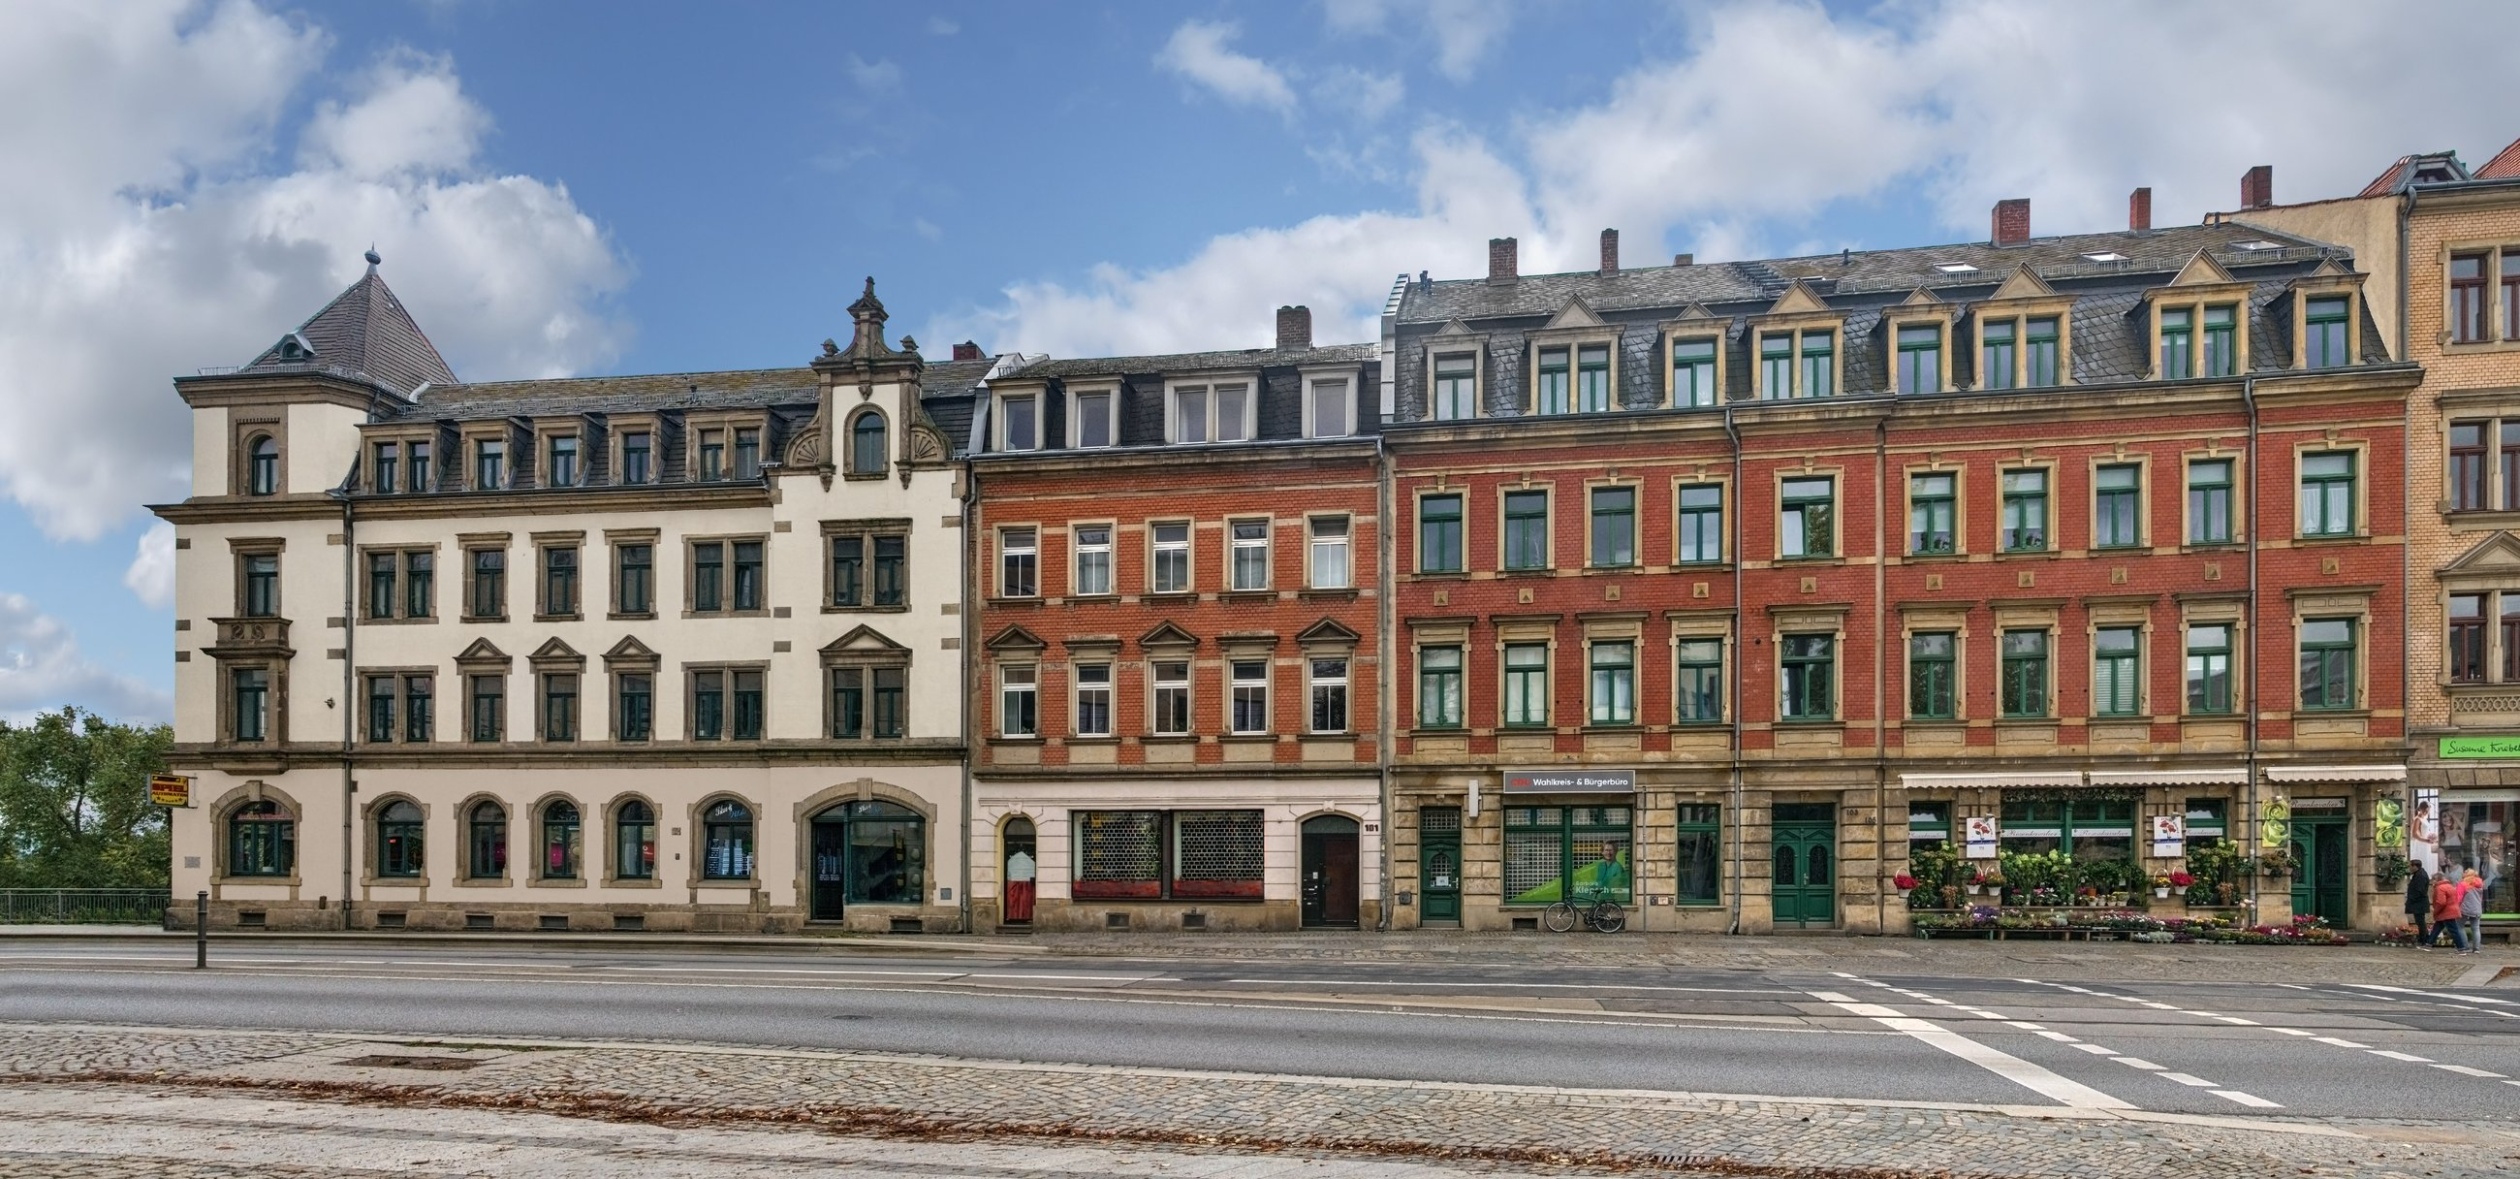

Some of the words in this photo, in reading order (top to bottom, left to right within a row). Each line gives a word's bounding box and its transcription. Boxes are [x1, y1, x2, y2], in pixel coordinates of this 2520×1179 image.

[2447, 740, 2486, 754] Susanne
[1533, 778, 1574, 786] Wahlkreis-
[1576, 778, 1583, 786] &
[1584, 778, 1628, 787] Bürgerbüro
[1364, 824, 1379, 832] 101
